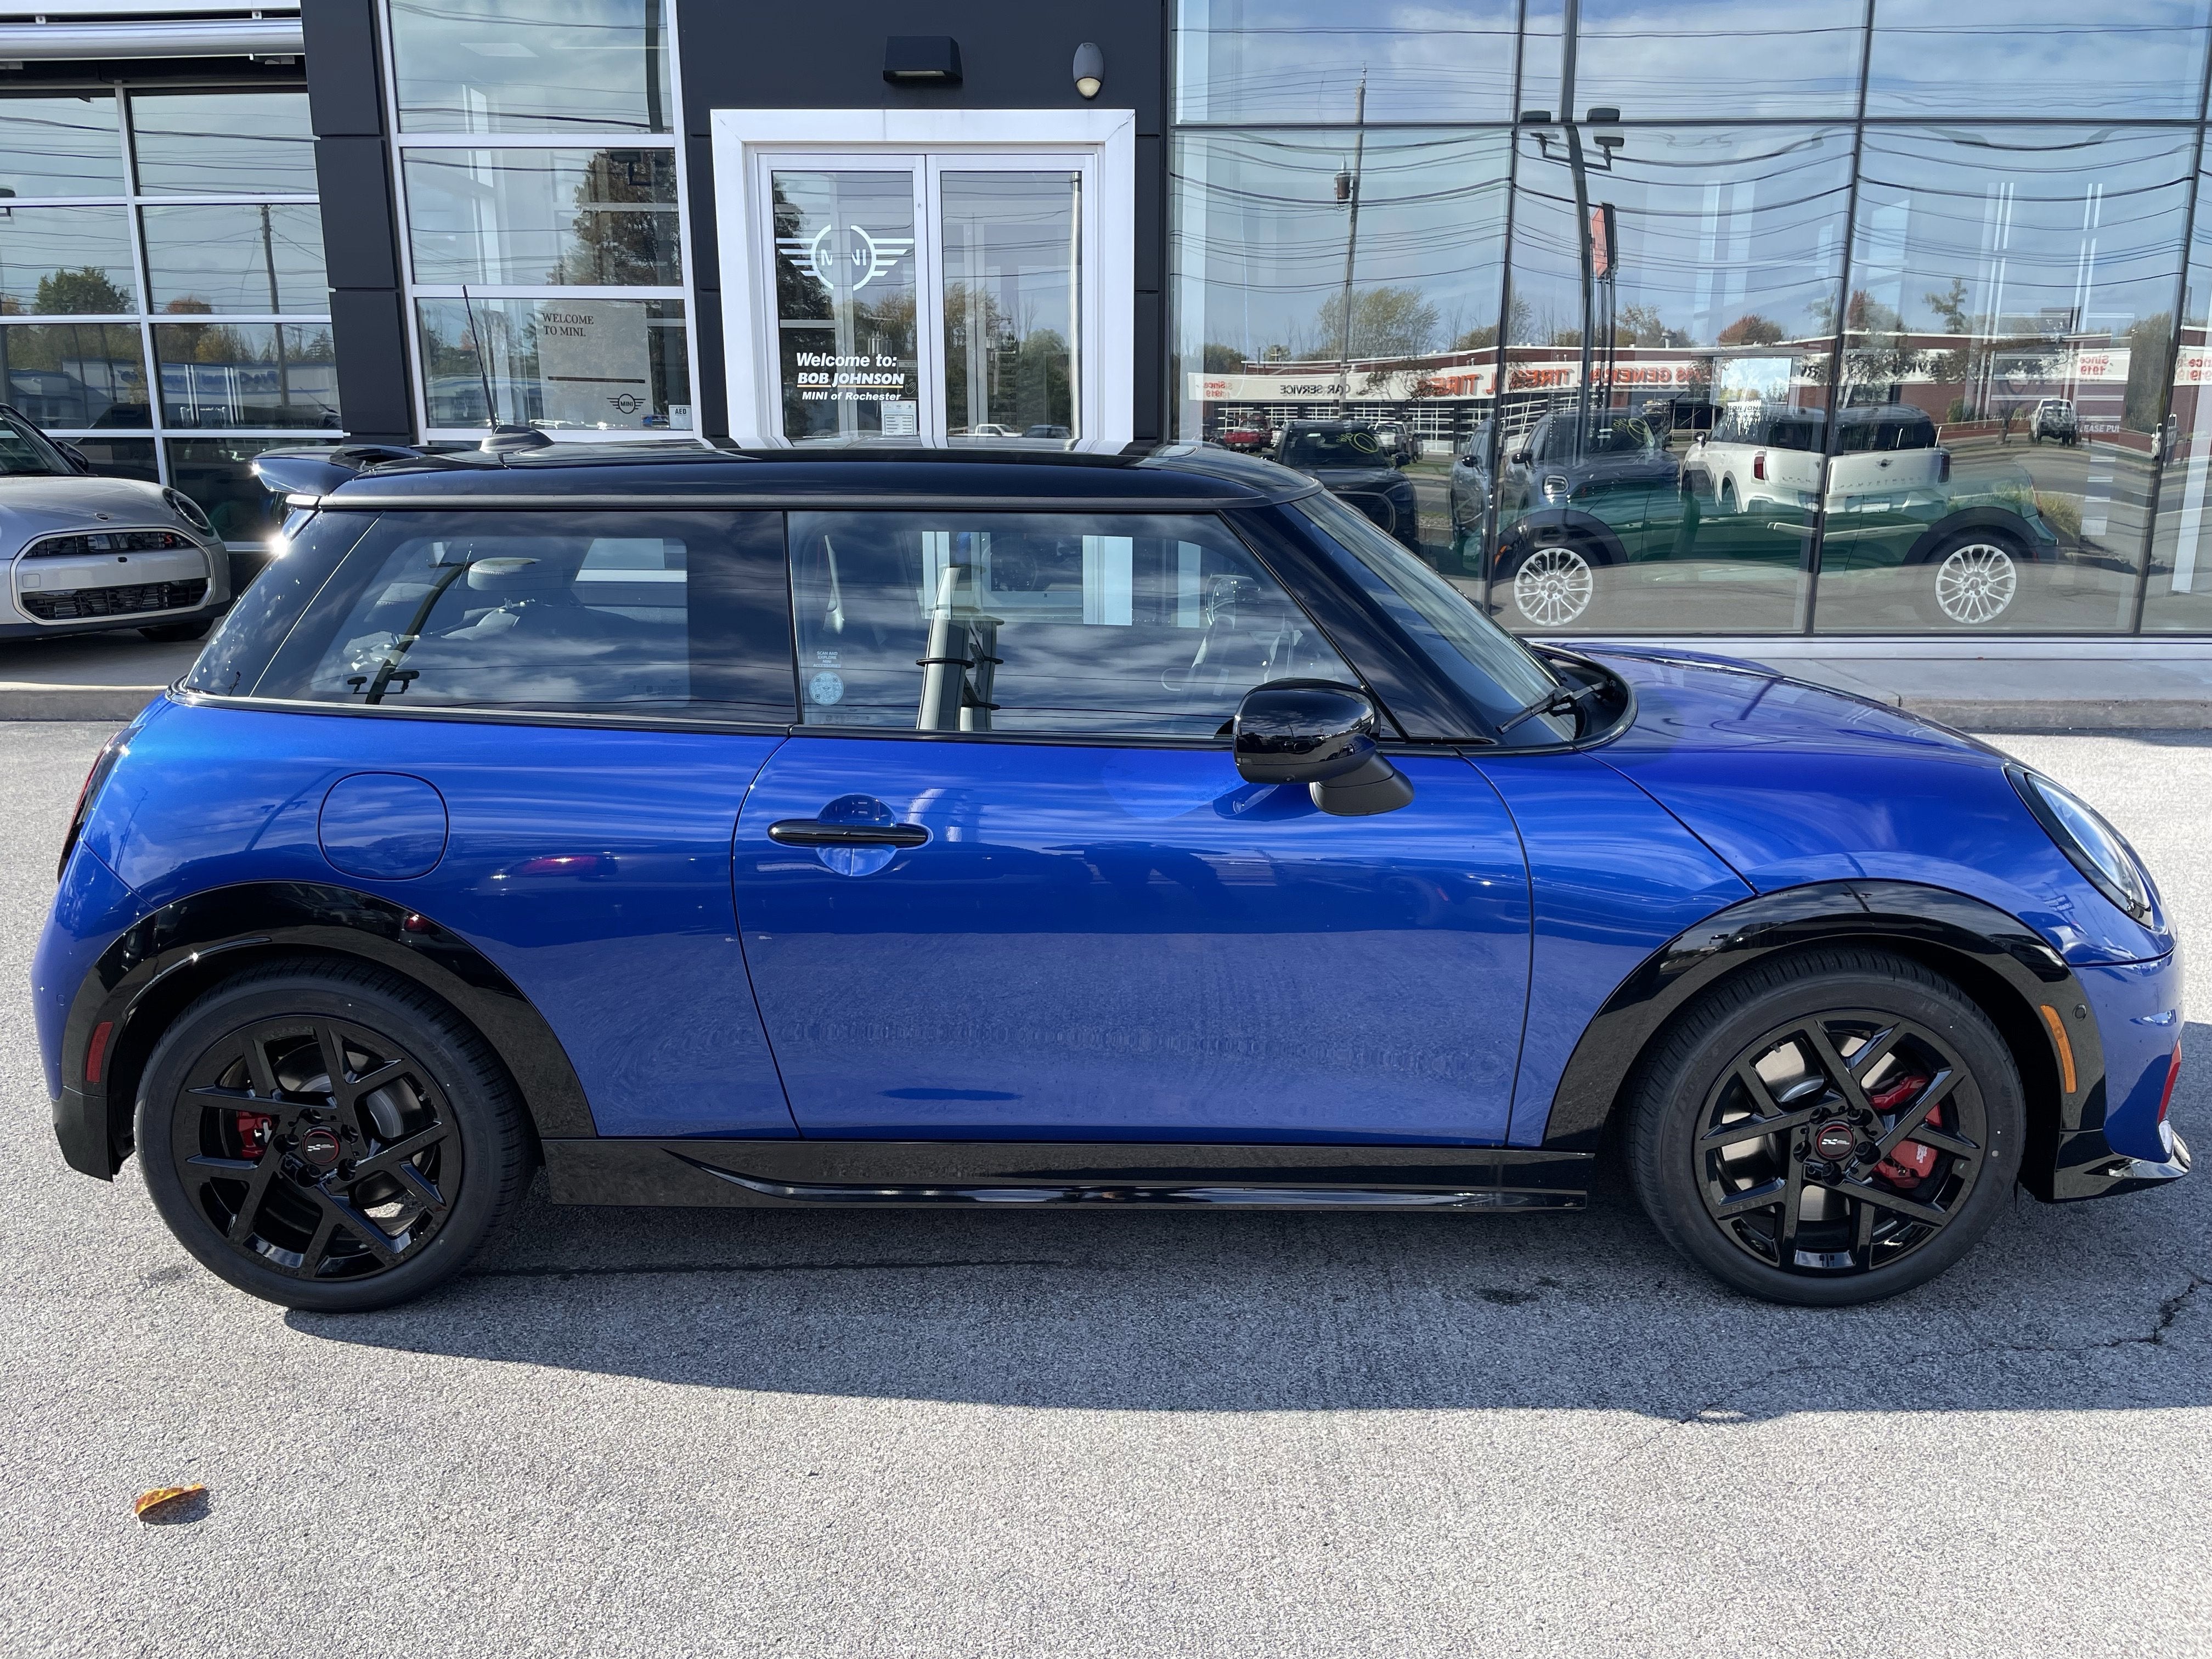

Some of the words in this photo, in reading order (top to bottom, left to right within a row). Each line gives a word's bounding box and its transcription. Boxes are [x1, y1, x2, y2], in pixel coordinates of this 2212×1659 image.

[821, 249, 867, 266] MNI
[541, 313, 594, 325] WELCOME
[543, 325, 557, 336] TO
[560, 326, 586, 337] MINI.
[797, 352, 870, 367] Welcome
[876, 353, 898, 367] to:
[797, 373, 829, 384] BOB
[832, 373, 905, 387] JOHNSON
[802, 391, 828, 400] MINI
[831, 392, 843, 400] of
[845, 392, 902, 400] Rochester
